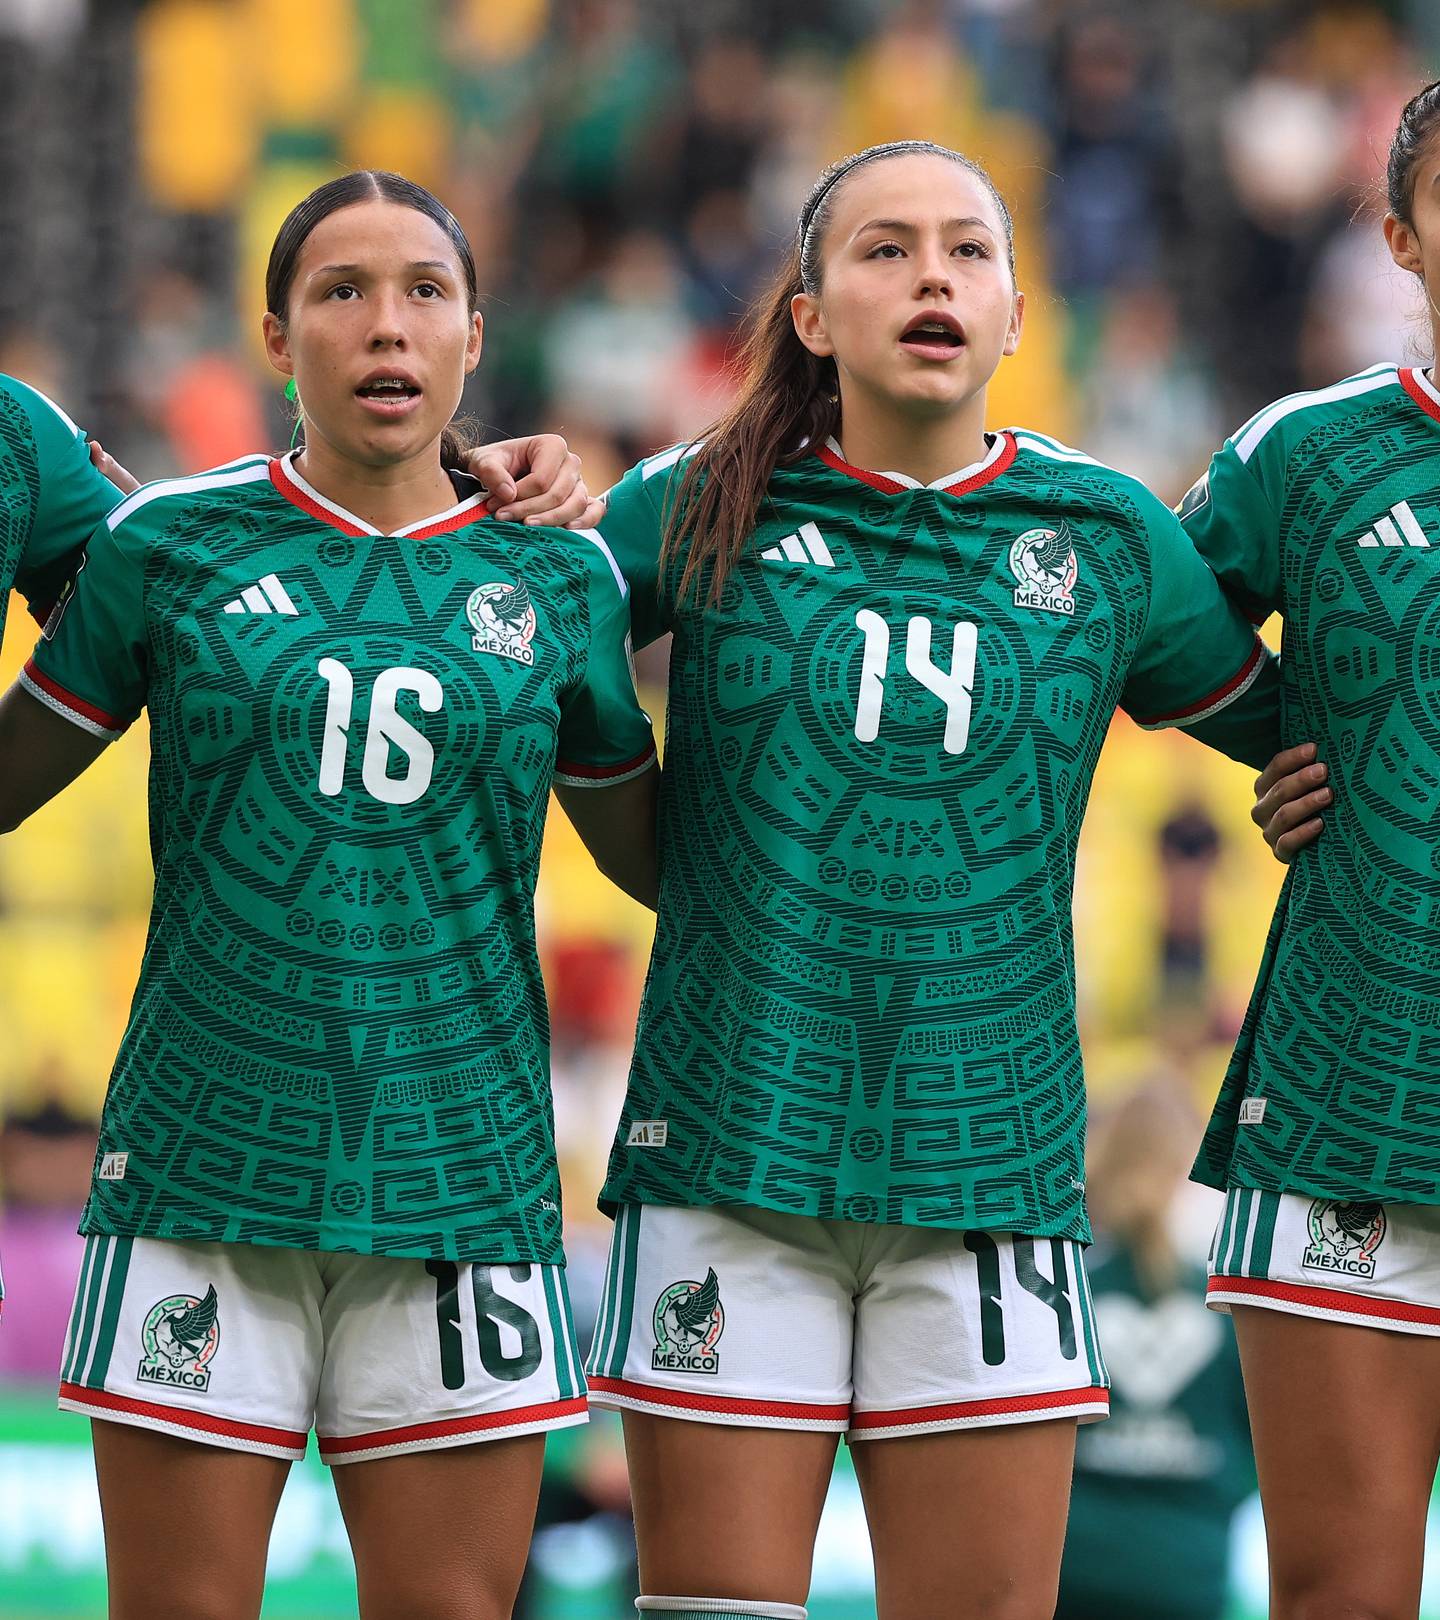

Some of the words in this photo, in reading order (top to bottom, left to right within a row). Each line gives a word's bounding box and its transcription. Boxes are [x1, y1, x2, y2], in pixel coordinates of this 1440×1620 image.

[1016, 590, 1073, 612] MÉXICO
[474, 637, 533, 662] MÉXICO
[853, 609, 979, 756] 14
[317, 658, 444, 805] 16
[1307, 1250, 1372, 1275] MÉXICO
[962, 1231, 1078, 1366] 14
[424, 1261, 542, 1390] 16
[655, 1352, 715, 1371] MÉXICO
[141, 1362, 207, 1387] MÉXICO
